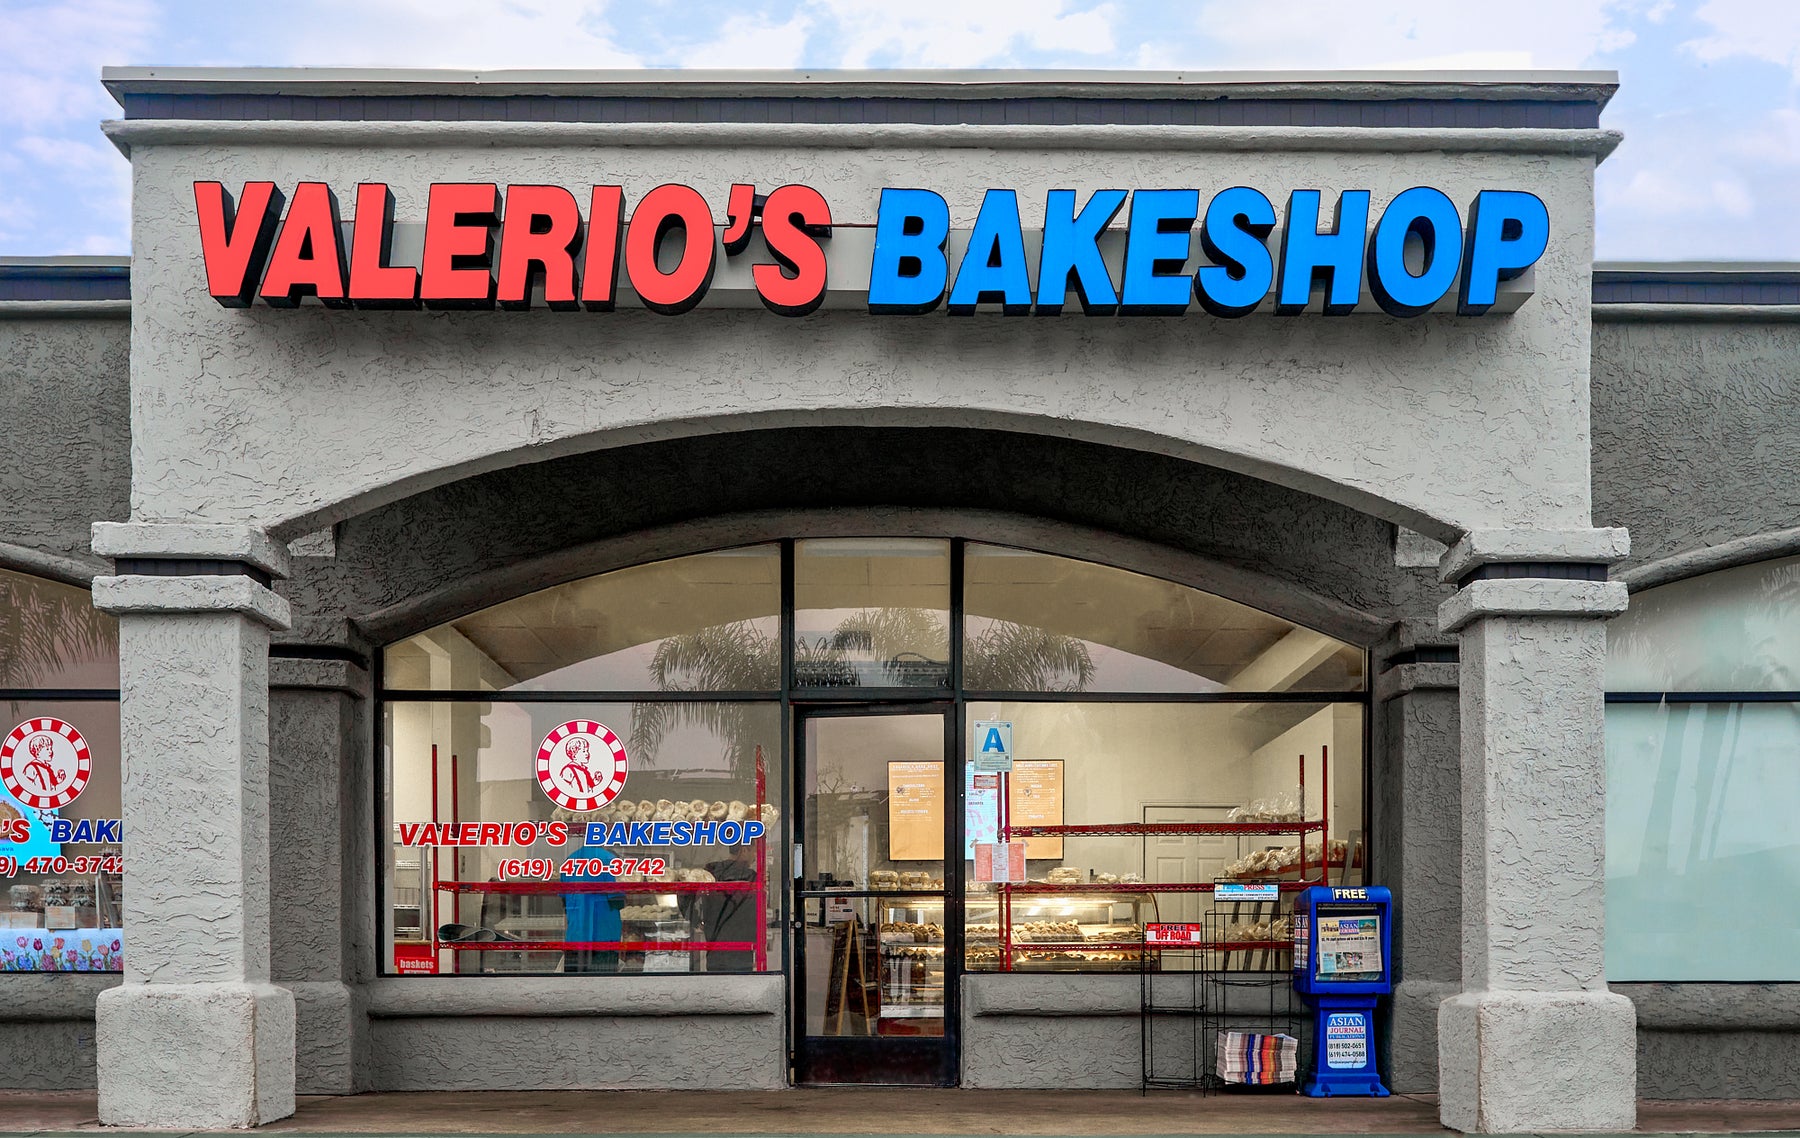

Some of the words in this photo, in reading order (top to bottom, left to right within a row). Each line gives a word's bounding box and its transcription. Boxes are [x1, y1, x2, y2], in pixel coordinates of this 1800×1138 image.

[193, 180, 832, 312] VALERIO'S
[868, 186, 1549, 314] BAKESHOP
[982, 727, 1005, 753] A
[51, 819, 122, 843] BAK
[399, 822, 568, 847] VALERIO'S
[585, 821, 765, 846] BAKESHOP
[498, 859, 554, 881] (619)
[560, 858, 665, 877] 470-3742
[1335, 889, 1366, 899] FREE
[1170, 931, 1191, 940] ROAD
[400, 960, 434, 969] baskets
[1330, 1017, 1364, 1026] ASIAN
